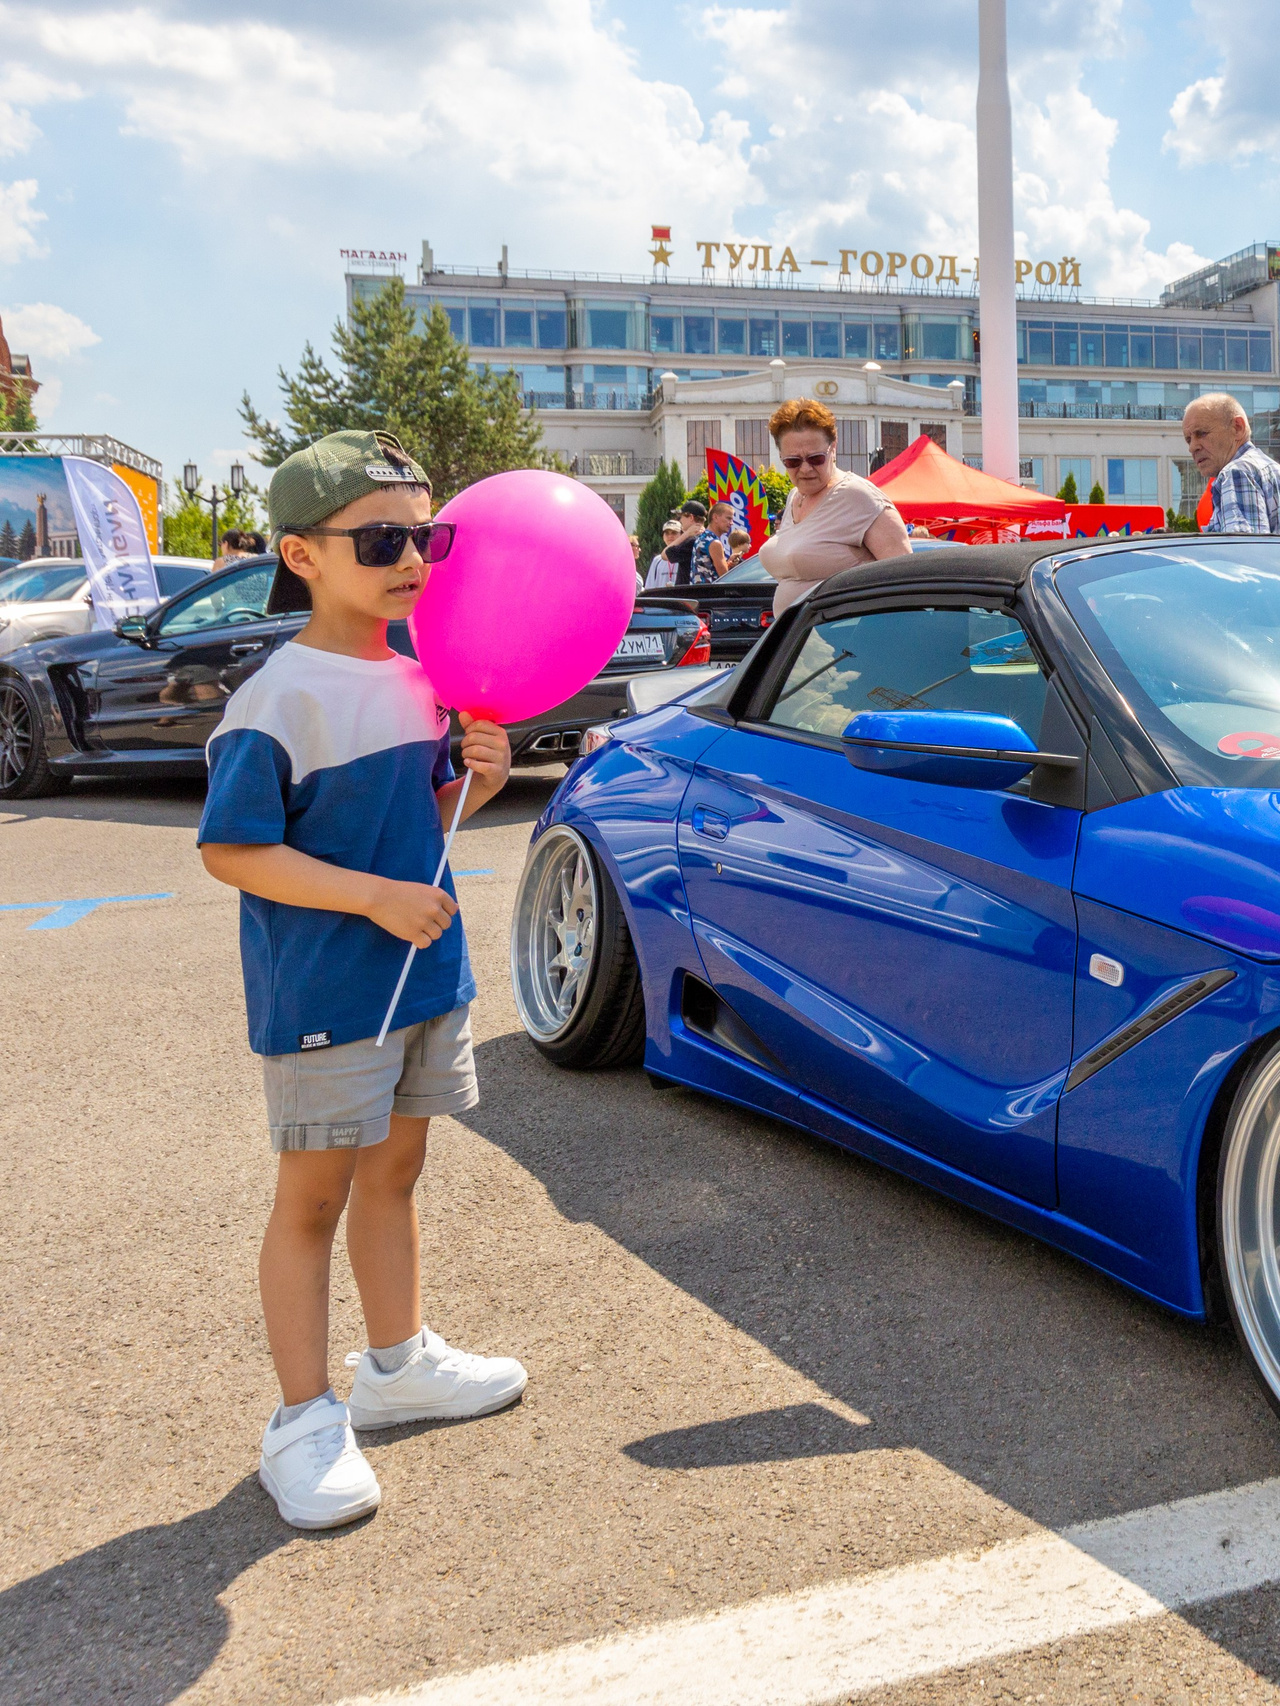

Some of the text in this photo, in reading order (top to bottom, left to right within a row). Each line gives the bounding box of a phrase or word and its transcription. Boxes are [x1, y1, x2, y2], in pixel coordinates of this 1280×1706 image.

[340, 248, 407, 261] МАГАДАН
[696, 241, 802, 272] ТУЛА
[839, 249, 1082, 287] ГОРОД-РОЙ
[616, 636, 659, 654] 2УМ 71
[303, 1032, 326, 1044] FUTURE
[332, 1127, 359, 1137] HAPPY
[333, 1136, 357, 1146] SMILE
